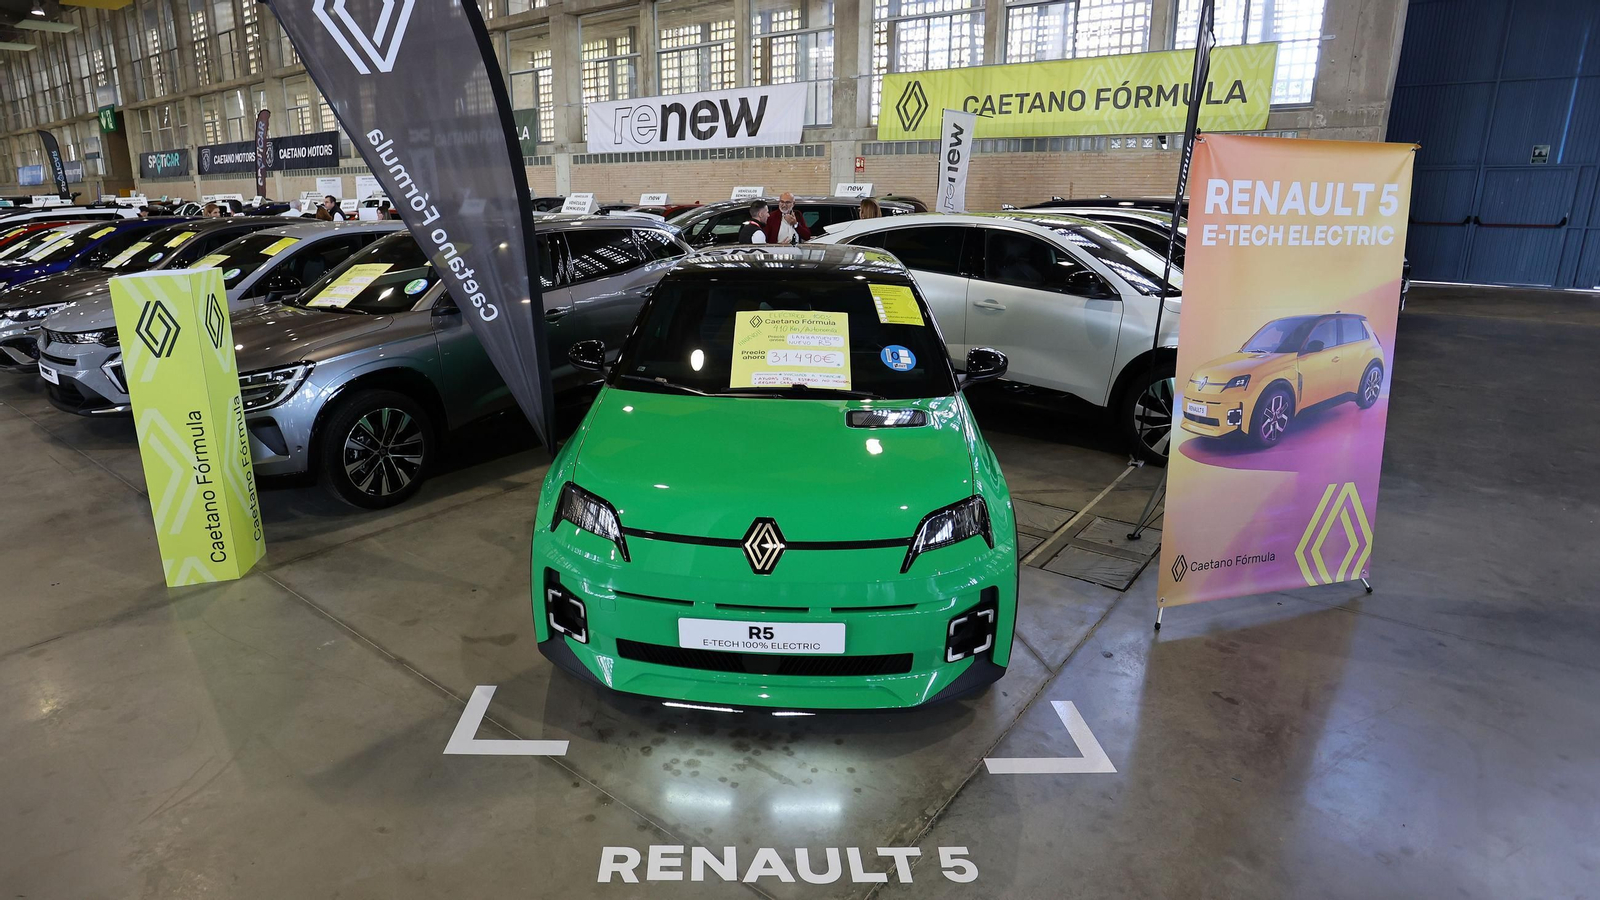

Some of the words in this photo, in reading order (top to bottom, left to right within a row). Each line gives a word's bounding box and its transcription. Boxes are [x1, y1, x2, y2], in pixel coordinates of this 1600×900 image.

[963, 89, 1086, 116] CAETANO
[614, 95, 769, 144] renew
[213, 153, 234, 165] CAETANO
[234, 151, 256, 163] MOTORS
[278, 146, 307, 159] CAETANO
[307, 144, 333, 156] MOTORS
[944, 122, 966, 210] renew
[1204, 178, 1376, 217] RENAULT
[1378, 183, 1399, 217] 5
[1201, 224, 1284, 246] E-TECH
[1287, 225, 1395, 246] ELECTRIC
[801, 318, 836, 326] Fórmula
[186, 409, 213, 486] Fórmula
[232, 395, 249, 468] Fórmula
[245, 470, 262, 542] Caetano
[203, 489, 228, 564] Caetano
[1190, 557, 1233, 573] Caetano
[1235, 552, 1276, 570] Fórmula
[702, 638, 740, 648] E-TECH
[742, 641, 769, 650] 100%
[771, 642, 821, 650] ELECTRIC
[748, 626, 775, 640] R5
[597, 844, 922, 885] RENAULT
[938, 845, 979, 884] 5
